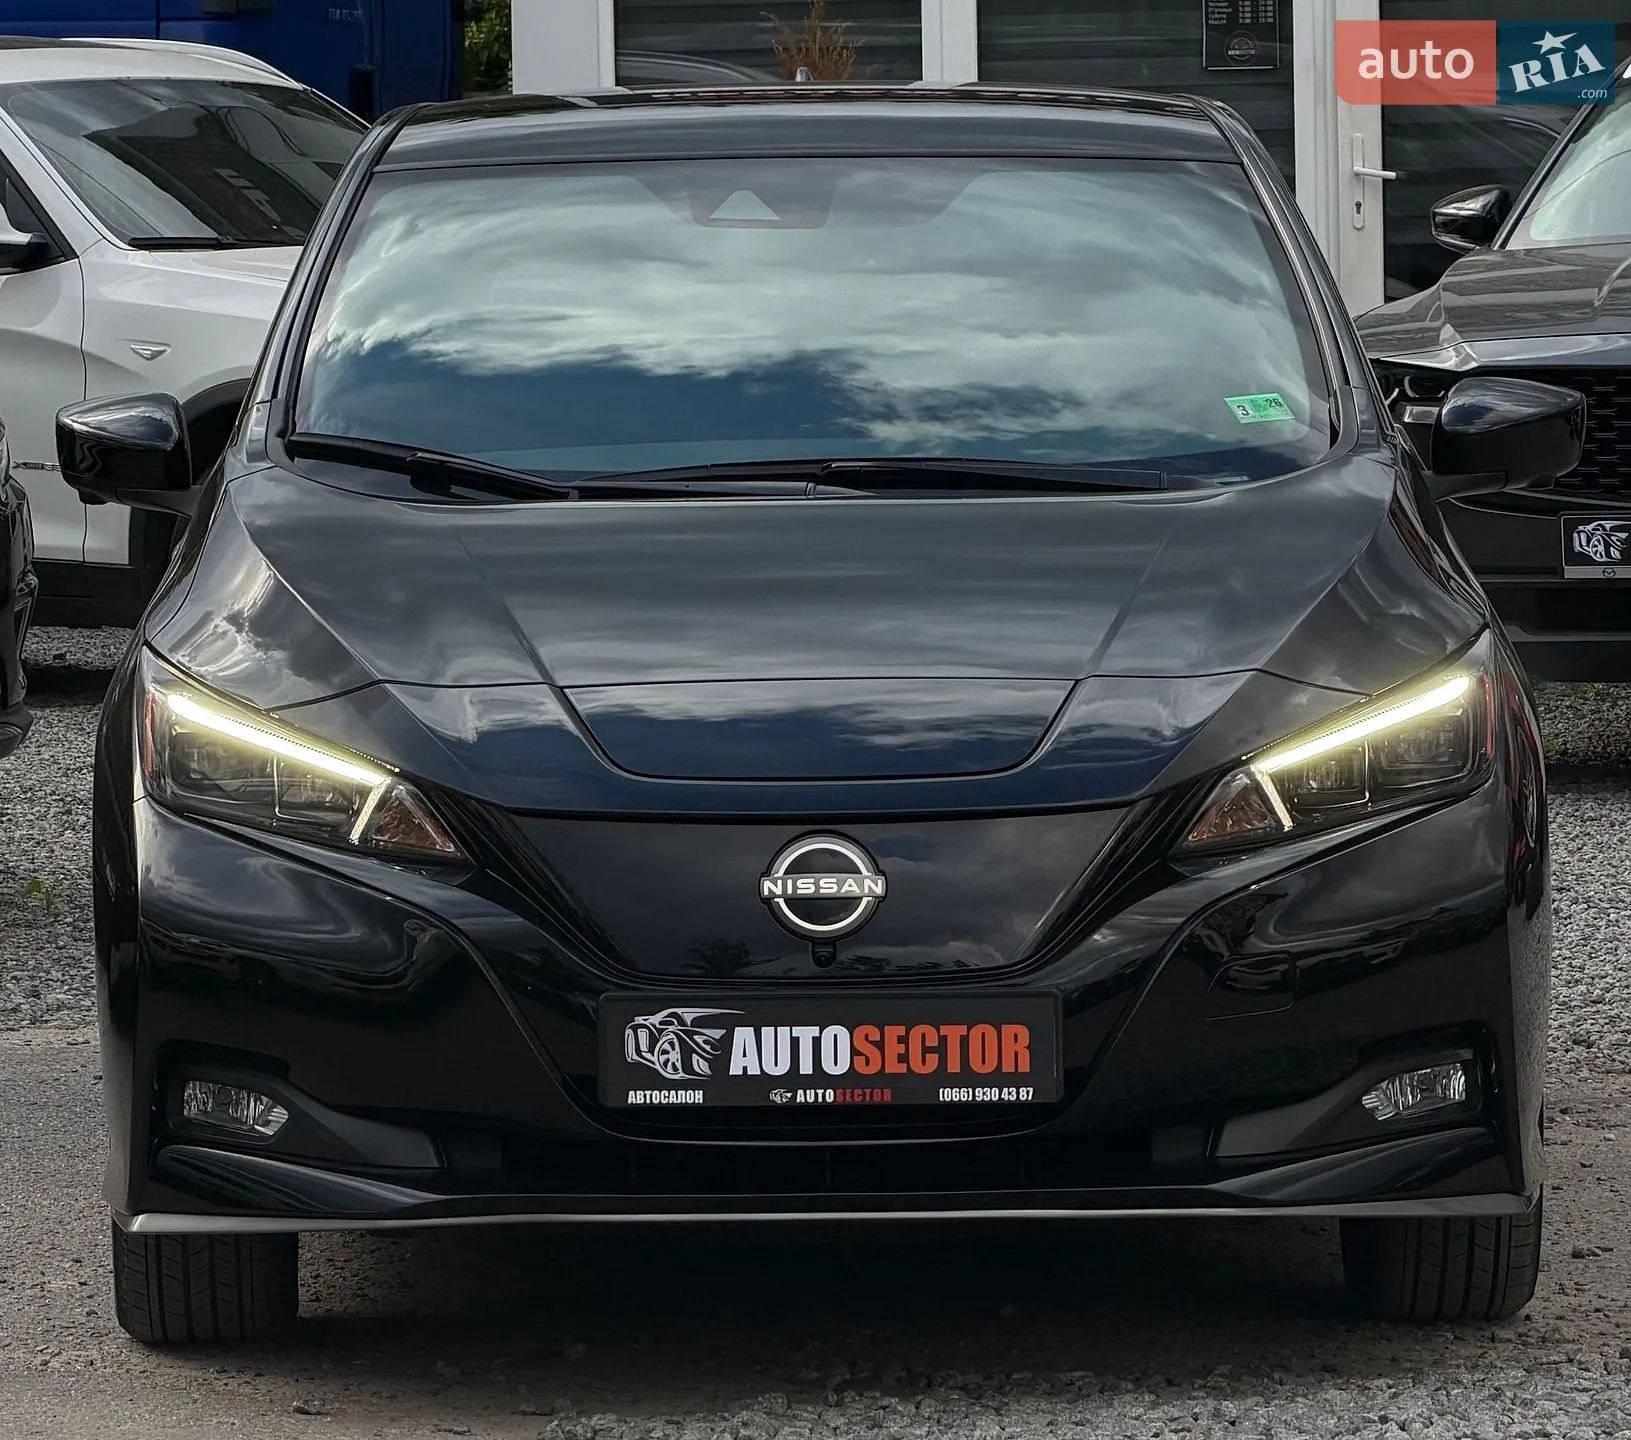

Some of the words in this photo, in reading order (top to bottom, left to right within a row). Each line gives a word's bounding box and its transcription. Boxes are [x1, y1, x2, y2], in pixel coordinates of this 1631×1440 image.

[1237, 404, 1250, 416] 3
[763, 878, 883, 896] NISSAN
[728, 1023, 1031, 1076] AUTOSECTOR
[627, 1090, 704, 1104] АВТОСАЛОН
[796, 1088, 892, 1103] AUTOSECTOR
[938, 1088, 973, 1101] (066)
[974, 1088, 999, 1101] 930
[1001, 1088, 1017, 1101] 43
[1018, 1087, 1034, 1101] 87
